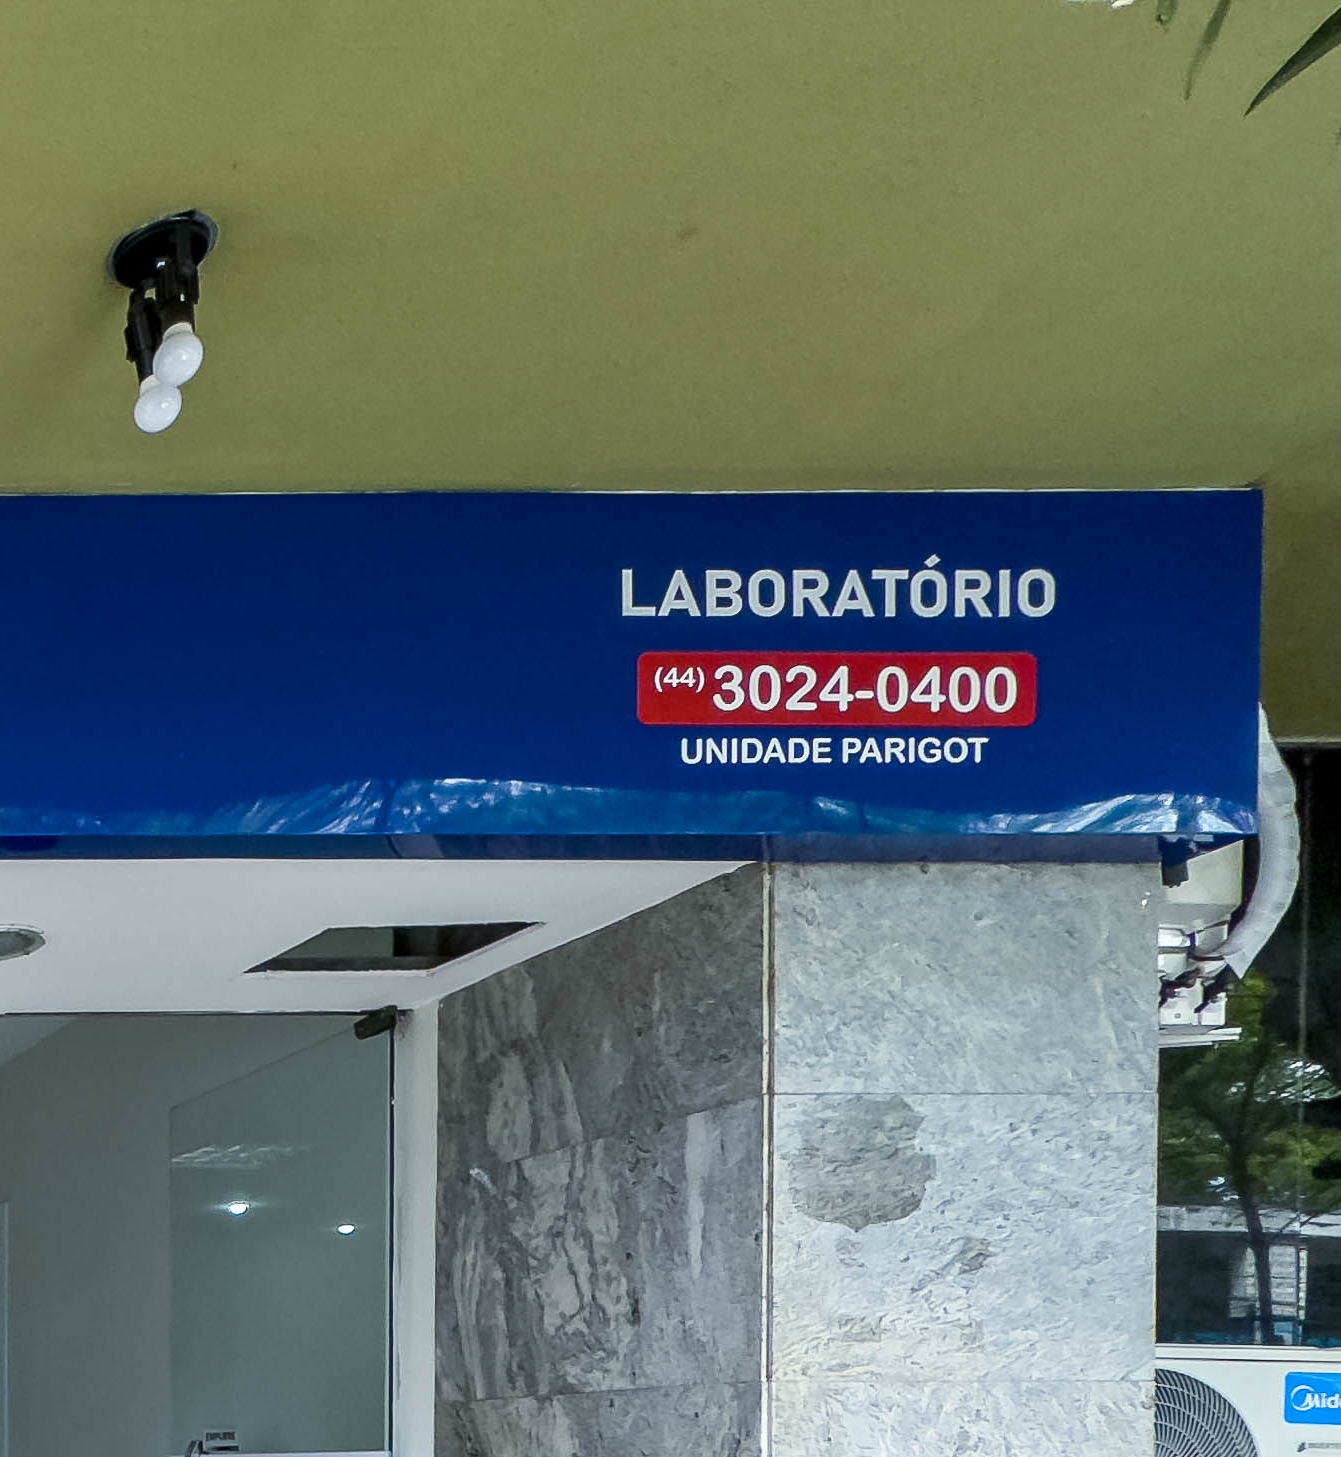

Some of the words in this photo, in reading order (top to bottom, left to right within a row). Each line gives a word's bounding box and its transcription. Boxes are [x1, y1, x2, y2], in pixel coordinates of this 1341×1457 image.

[621, 554, 1057, 619] LABORATÓRIO
[653, 665, 706, 693] (44)
[712, 663, 1019, 714] 3024-0400
[680, 737, 833, 765] UNIDADE
[841, 736, 990, 764] PARIGOT
